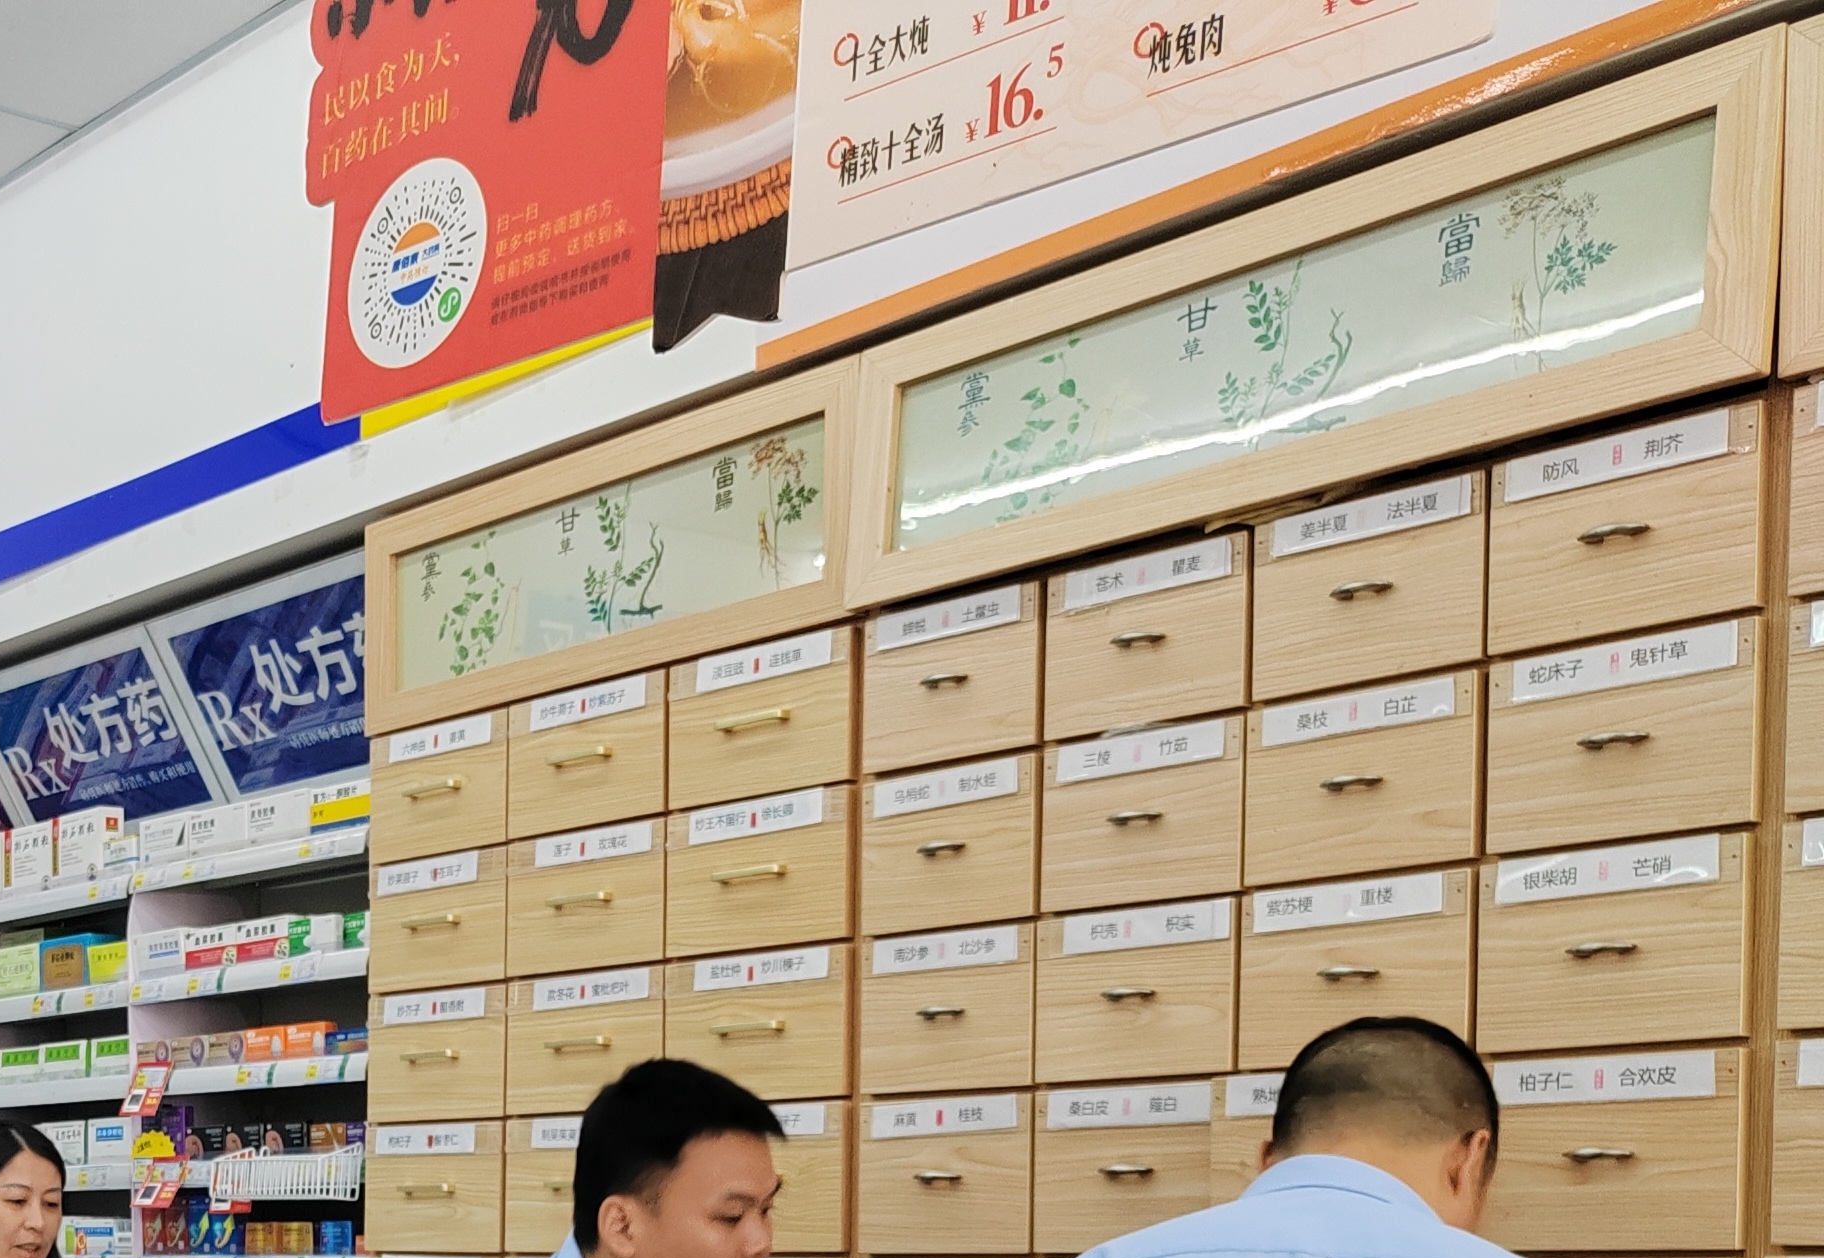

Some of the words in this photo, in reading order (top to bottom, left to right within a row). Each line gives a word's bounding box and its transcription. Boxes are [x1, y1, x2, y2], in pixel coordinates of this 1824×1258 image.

[845, 15, 931, 82] 十全大炖
[1148, 15, 1225, 79] 炖兔肉
[838, 113, 946, 188] 精致十全汤
[1177, 297, 1218, 364] 甘草
[1542, 458, 1580, 482] 防风
[1643, 433, 1685, 460] 荆芥
[555, 507, 581, 557] 甘草
[1299, 513, 1349, 542] 姜半夏
[1386, 492, 1439, 521] 法半夏
[197, 685, 278, 751] Rx
[249, 609, 366, 714] 处方
[1527, 659, 1585, 686] 蛇床子
[1629, 641, 1689, 669] 鬼针草
[1295, 711, 1329, 733] 桑枝
[1382, 695, 1418, 717] 白芷
[5, 745, 72, 803] Rx
[44, 677, 178, 770] 处方药
[1522, 867, 1578, 891] 银柴胡
[1631, 855, 1673, 878] 芒硝
[1265, 896, 1314, 917] 紫苏梗
[1359, 886, 1394, 907] 重楼
[1519, 1072, 1574, 1093] 柏子仁
[1618, 1065, 1678, 1087] 合欢皮
